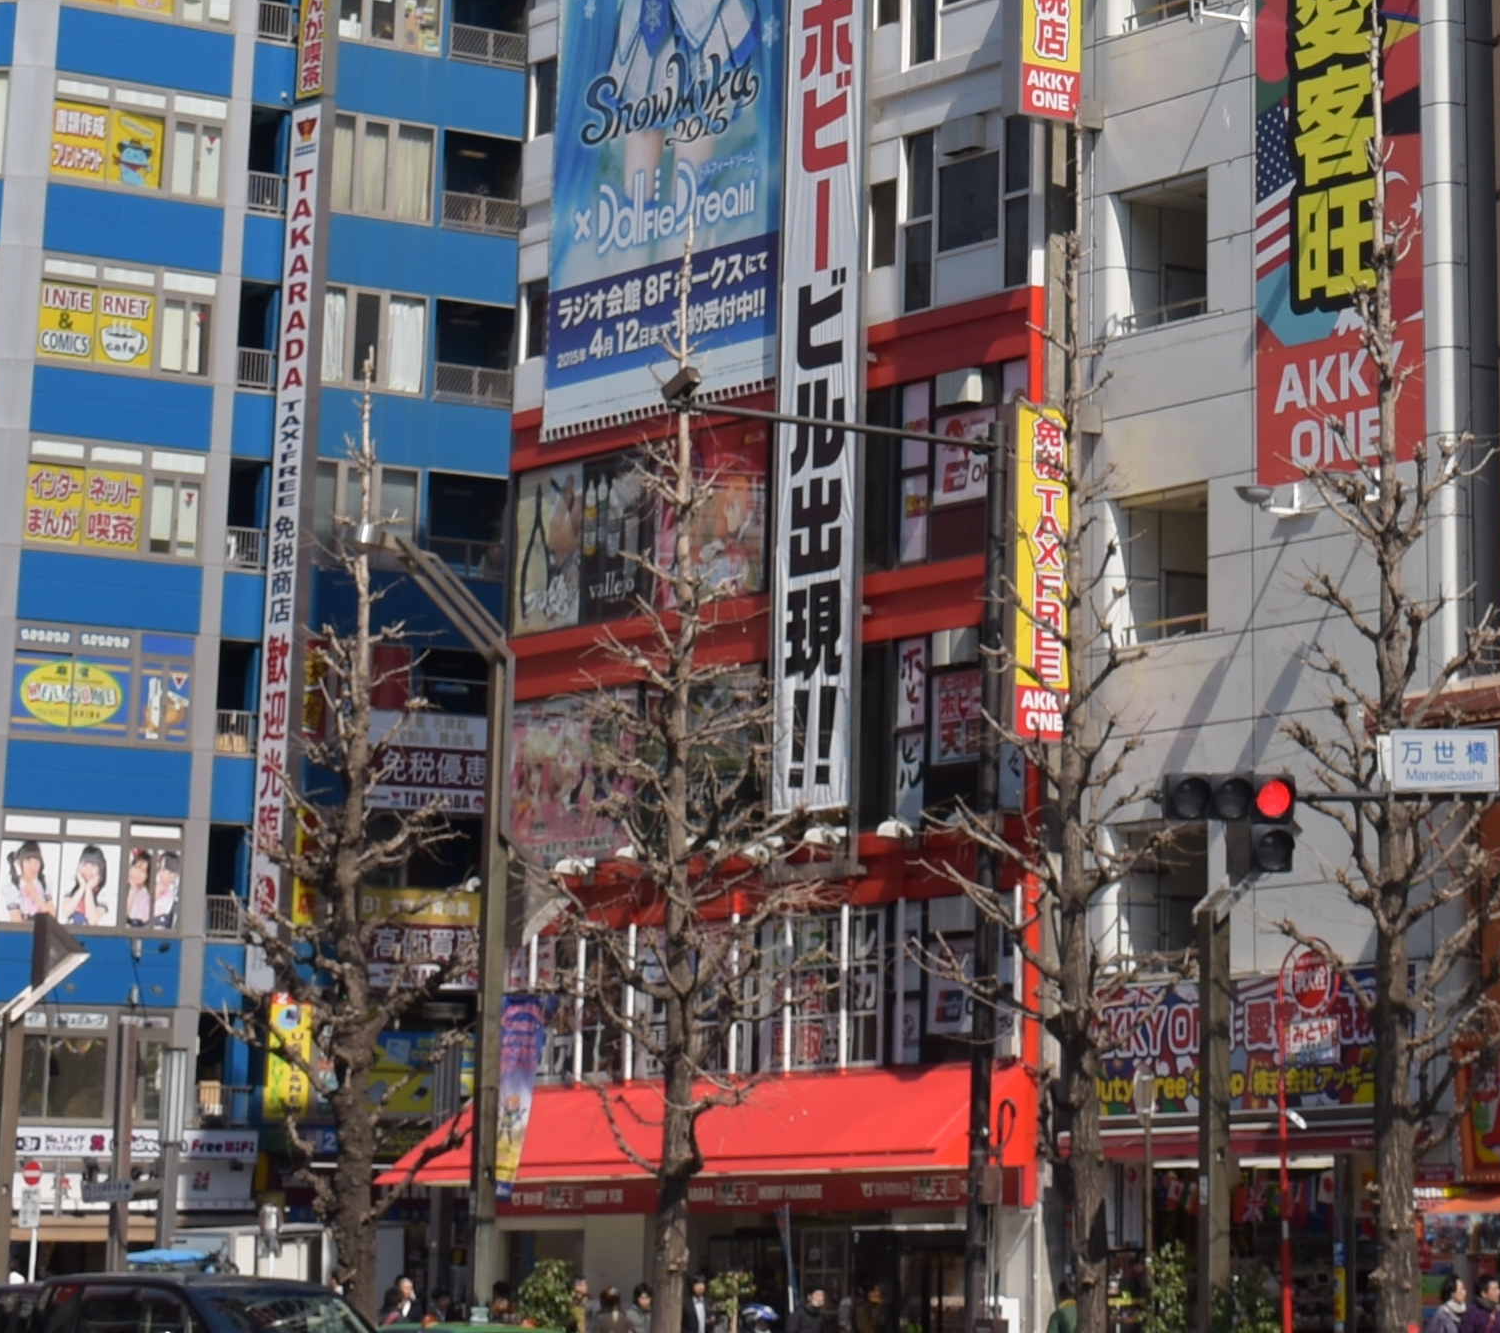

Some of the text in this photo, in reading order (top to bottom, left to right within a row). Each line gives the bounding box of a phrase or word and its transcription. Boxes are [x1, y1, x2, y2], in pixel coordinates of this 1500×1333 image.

[1026, 70, 1077, 112] AKKY ONE
[277, 166, 313, 390] TAKARADA
[40, 330, 91, 355] COMICS
[104, 339, 137, 355] cafe
[29, 469, 140, 507] インター ネット
[1032, 485, 1064, 569] TAX
[588, 566, 636, 601] vallejo
[1400, 739, 1490, 766] 万世橋
[1404, 766, 1484, 785] Manseibashi
